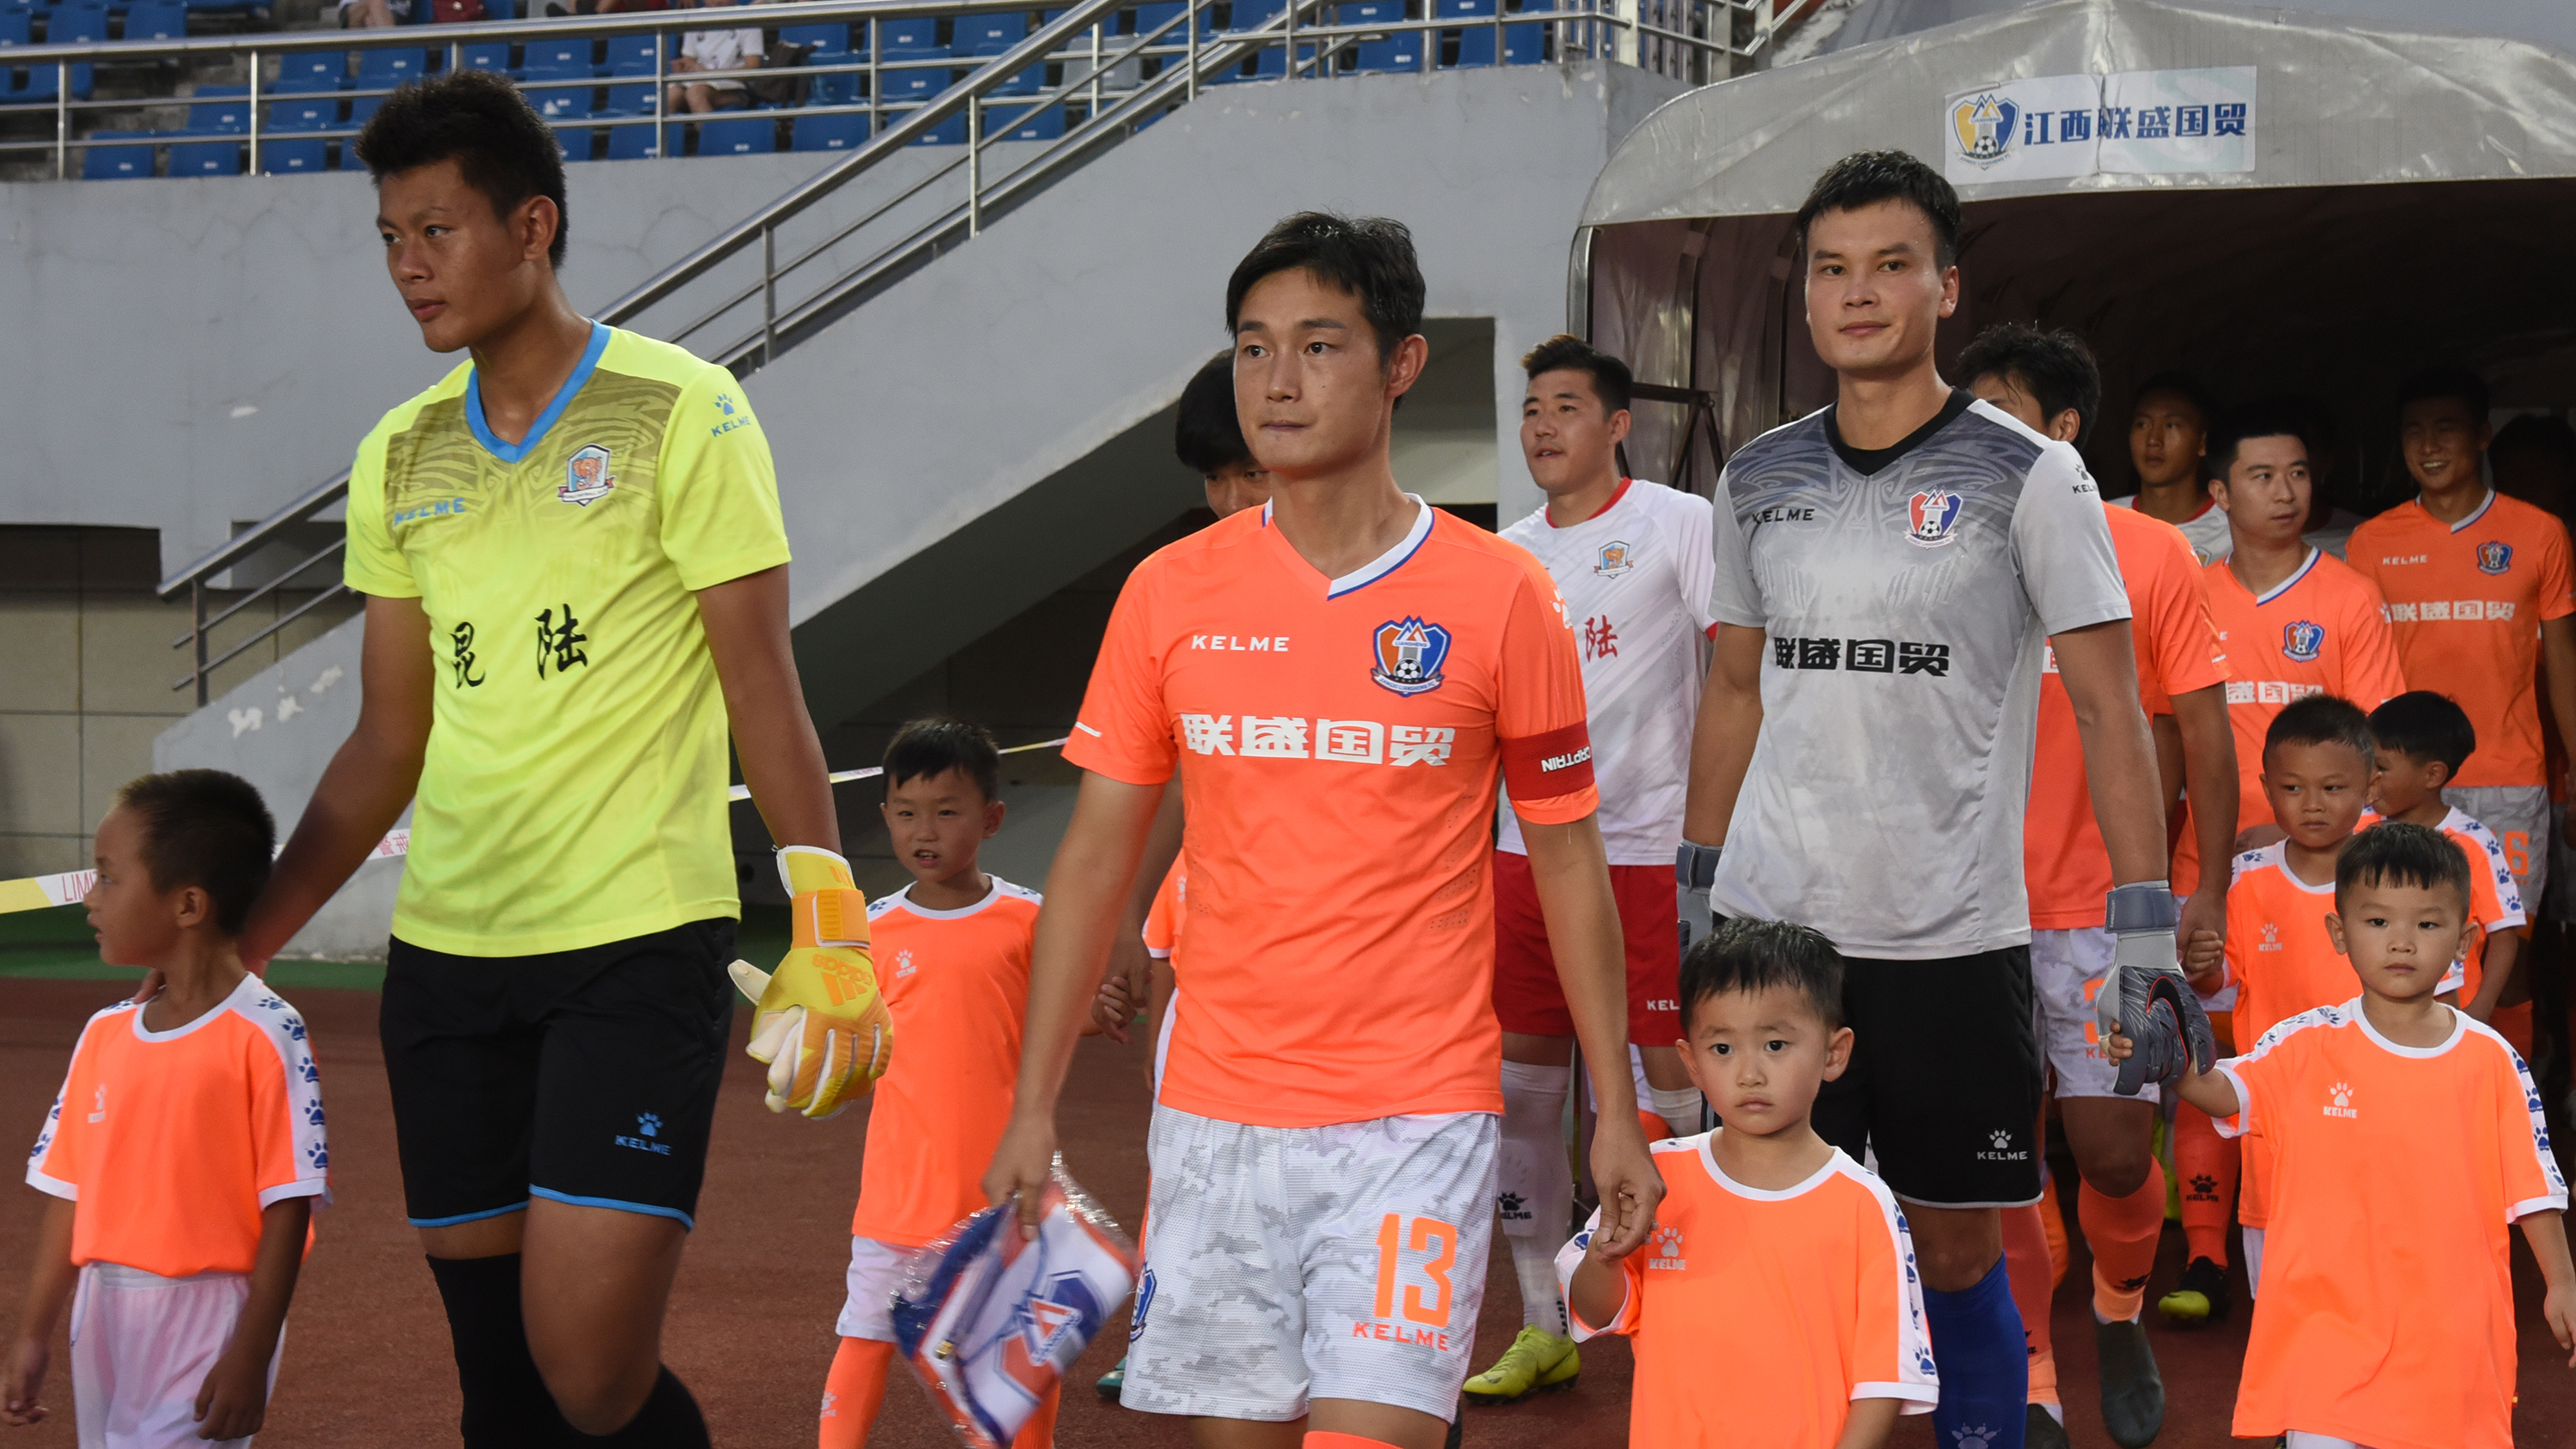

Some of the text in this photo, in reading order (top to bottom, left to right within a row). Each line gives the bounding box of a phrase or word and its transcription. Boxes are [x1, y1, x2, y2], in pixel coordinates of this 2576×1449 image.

[2024, 103, 2247, 145] 江西联盛国贸
[711, 416, 751, 437] KELME
[1753, 508, 1815, 524] KELME
[2383, 555, 2428, 566] KELME
[2391, 599, 2516, 621] 联盛国贸
[1191, 635, 1289, 652] KELME
[1774, 637, 1949, 676] 联盛国贸
[1180, 713, 1455, 767] 联盛国贸
[1541, 746, 1591, 773] CAPTAIN
[2324, 1106, 2357, 1119] KELME
[615, 1135, 671, 1155] KELME
[1977, 1151, 2027, 1161] KELME
[1374, 1213, 1458, 1328] 13
[1649, 1258, 1686, 1270] KELME
[1352, 1322, 1449, 1351] KELME
